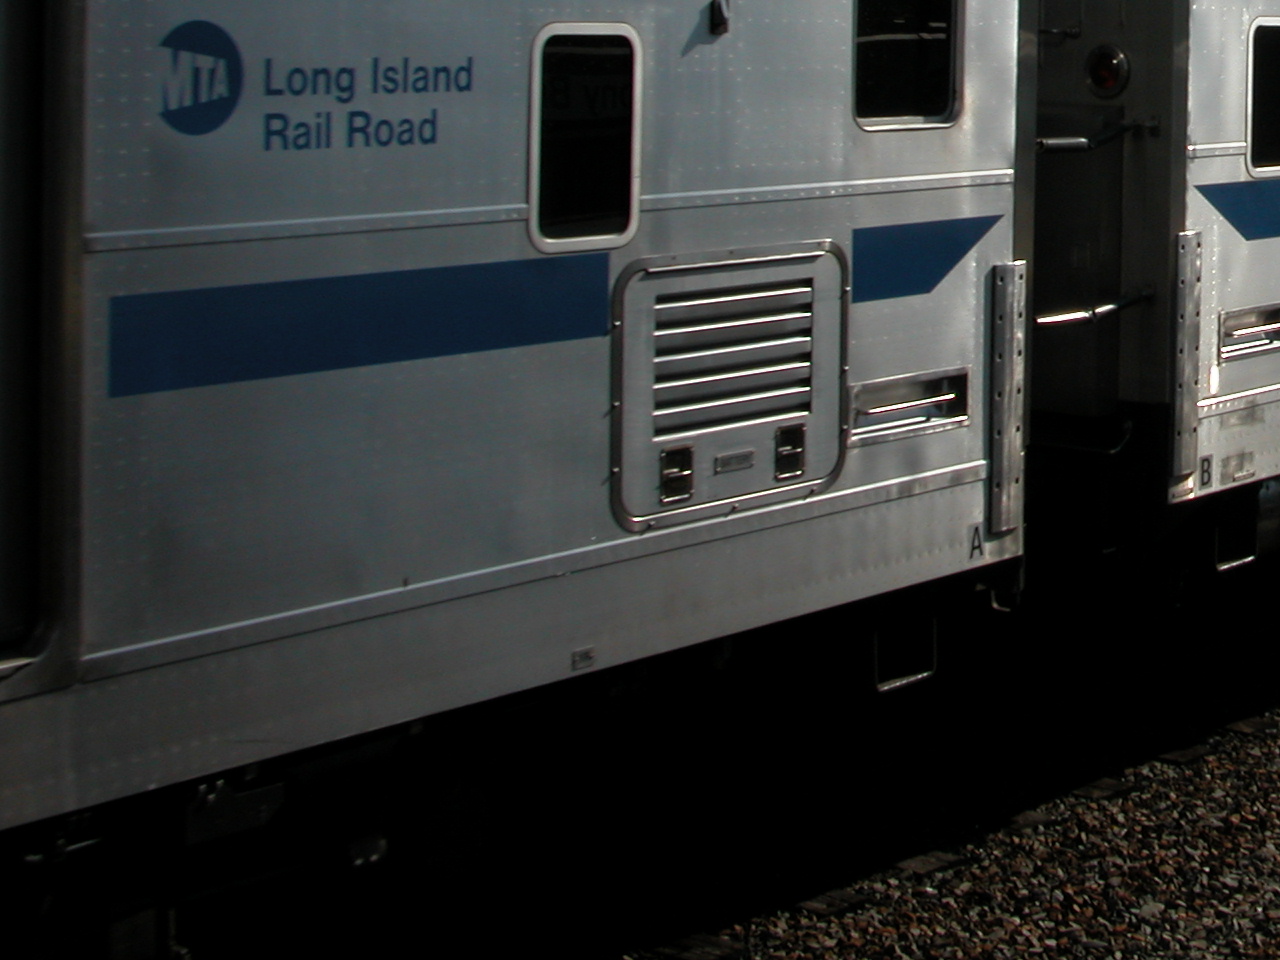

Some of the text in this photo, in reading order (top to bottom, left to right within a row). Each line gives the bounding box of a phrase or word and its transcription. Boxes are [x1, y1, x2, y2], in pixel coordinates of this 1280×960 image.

[158, 47, 231, 112] MTA
[263, 56, 474, 104] Long Island
[263, 108, 438, 152] Rail Road
[1201, 458, 1211, 486] B
[968, 526, 984, 560] A
